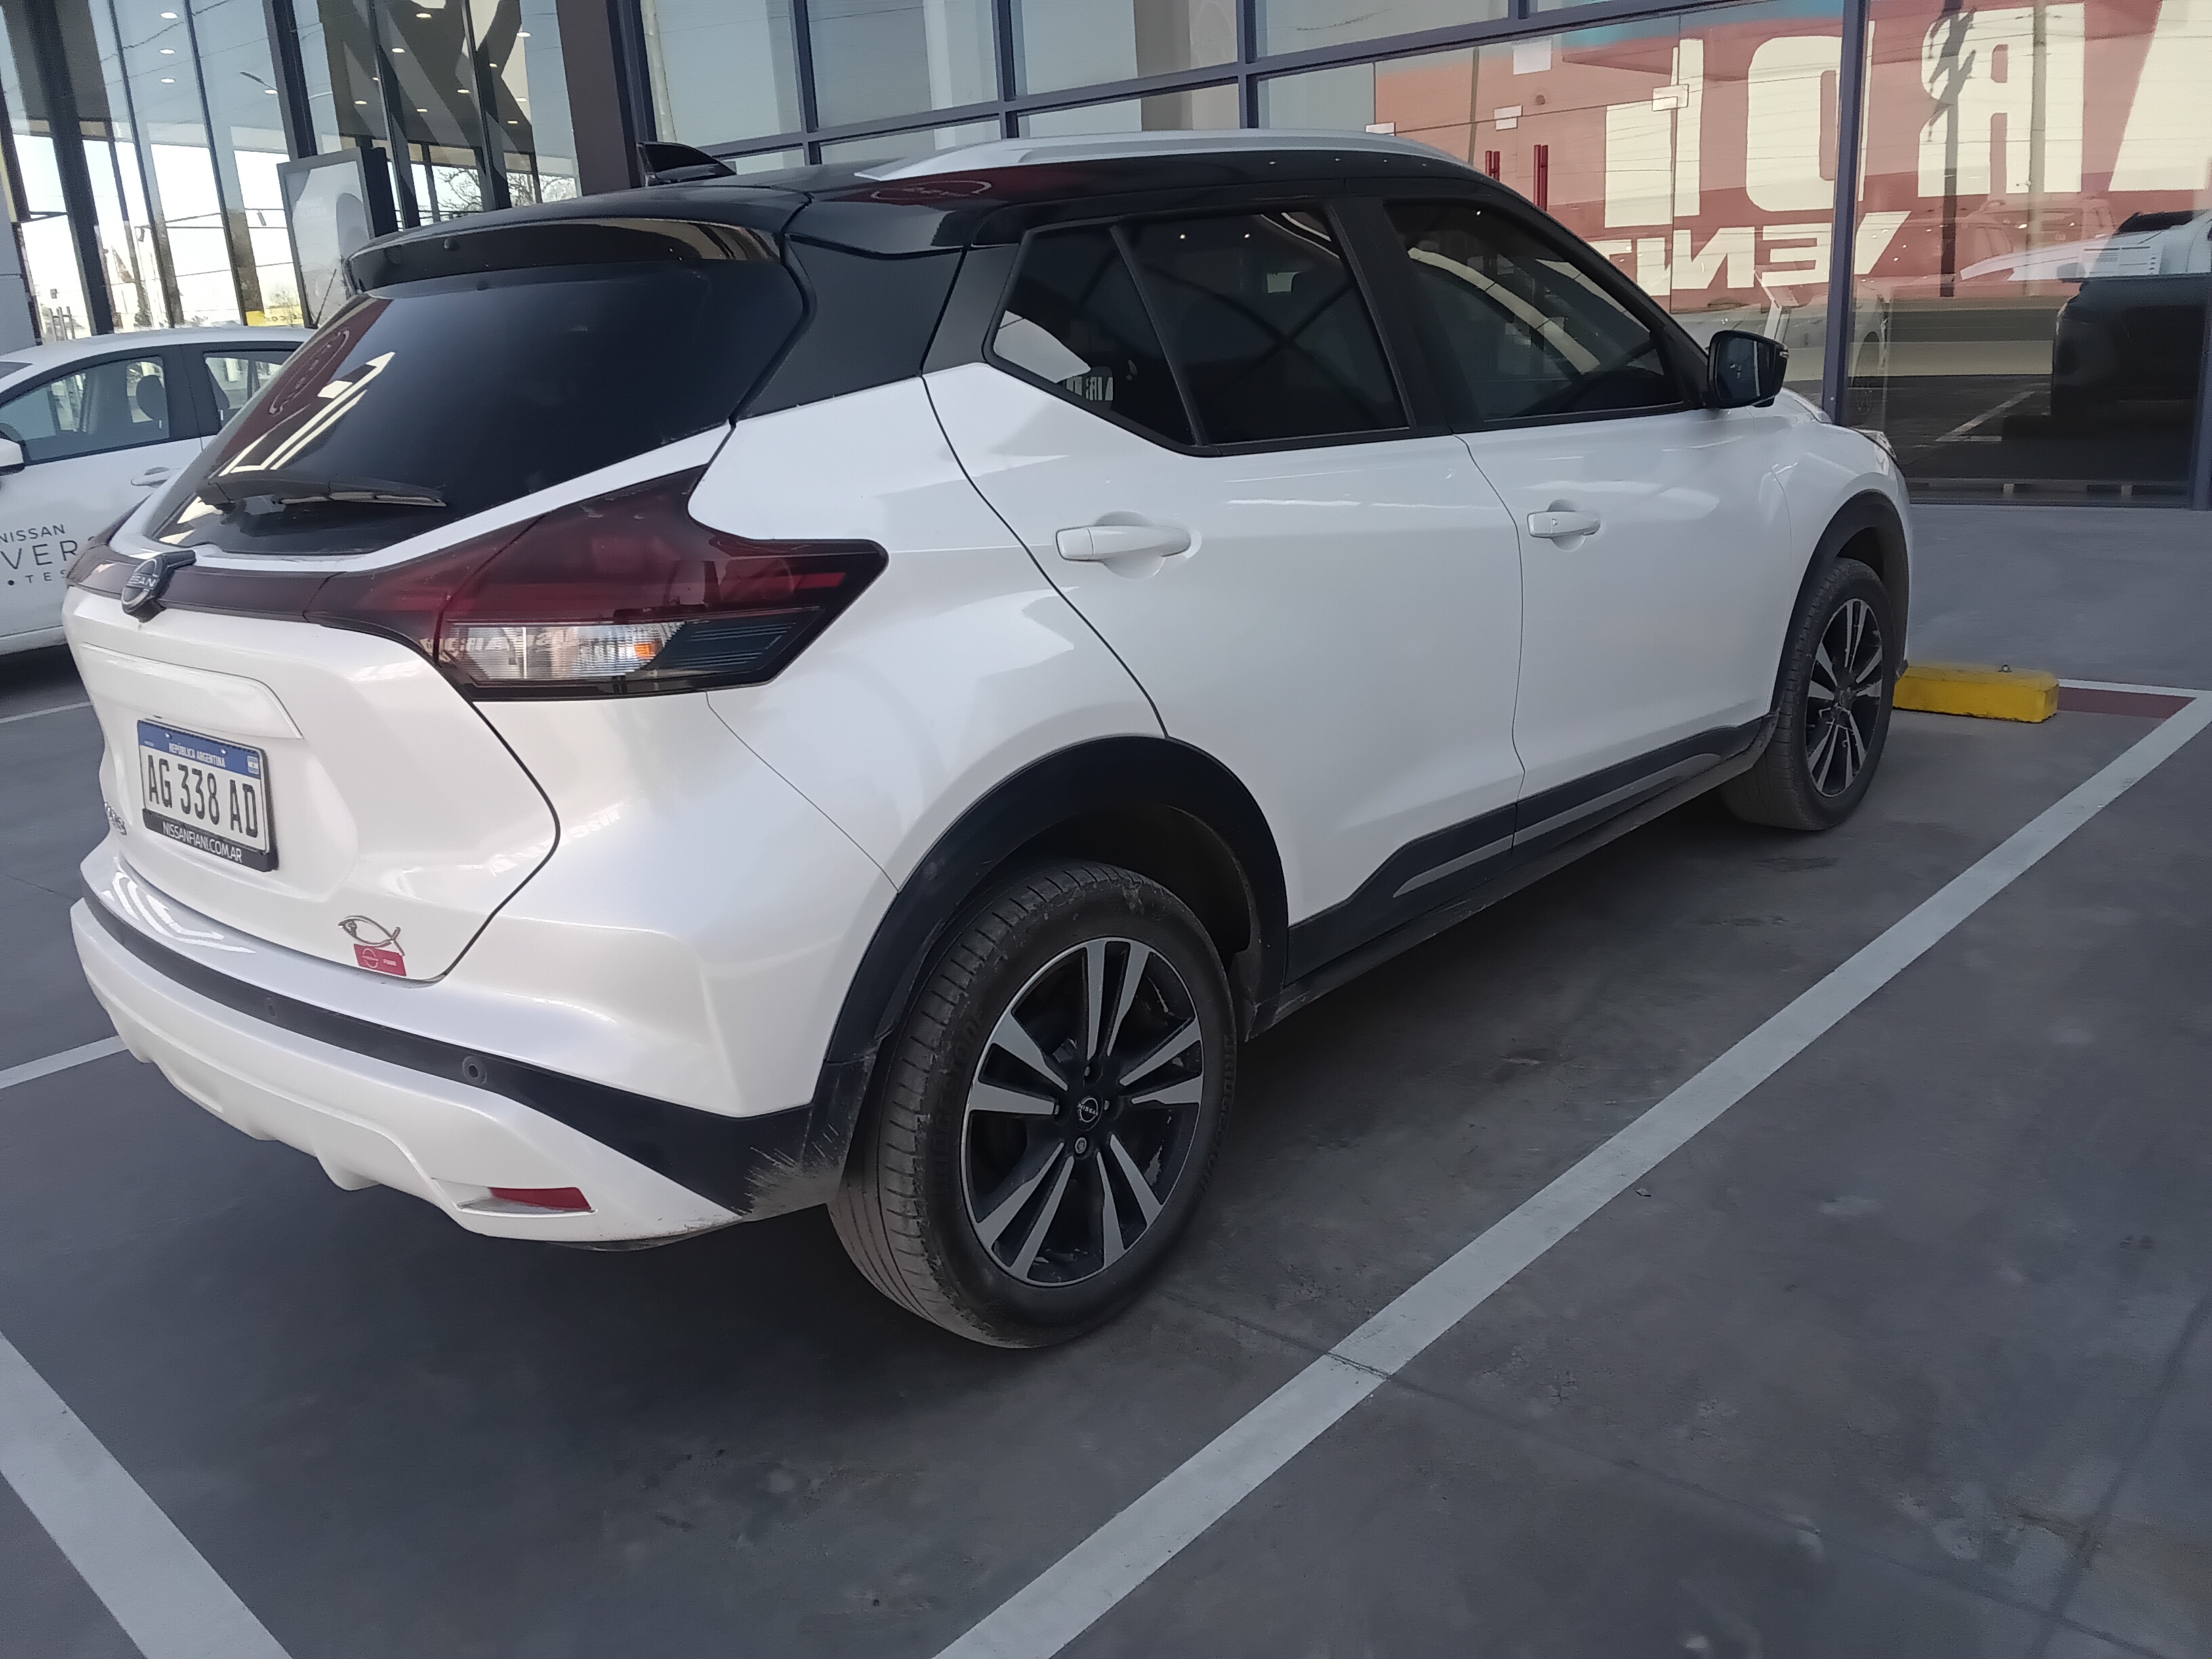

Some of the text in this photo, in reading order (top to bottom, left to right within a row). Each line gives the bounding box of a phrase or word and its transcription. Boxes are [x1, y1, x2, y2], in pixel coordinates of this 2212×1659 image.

[0, 524, 65, 543] NISSAN
[147, 754, 173, 808] AG
[178, 763, 220, 825] 338
[229, 779, 258, 838] AD
